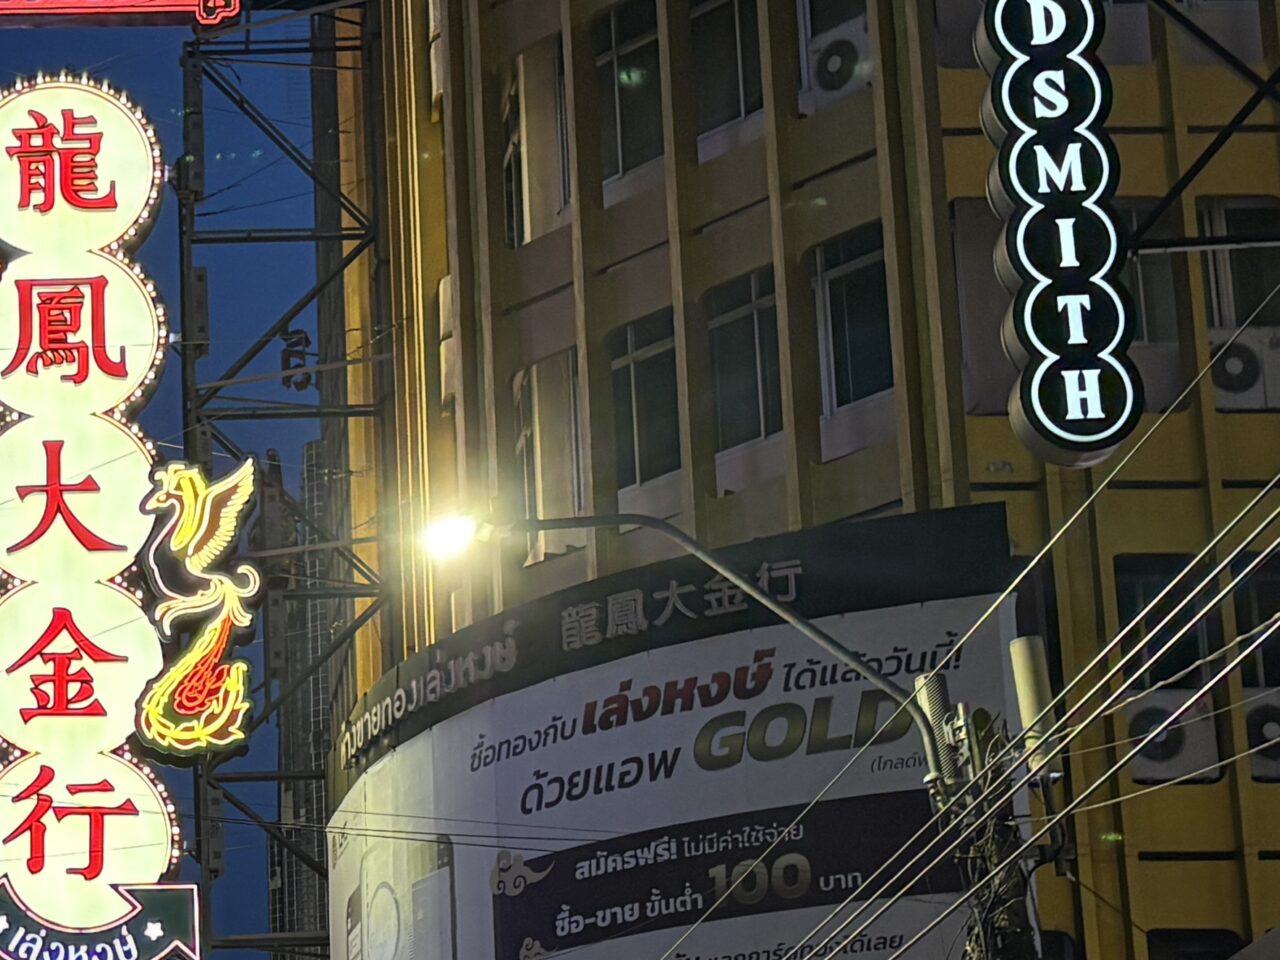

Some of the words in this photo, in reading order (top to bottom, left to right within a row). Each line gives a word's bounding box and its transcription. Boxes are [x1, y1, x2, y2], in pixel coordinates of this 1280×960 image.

[0, 109, 139, 880] 龍鳳大金行
[560, 559, 803, 652] 龍鳳大金行
[469, 713, 578, 773] ซื้อทองกับ
[580, 648, 779, 735] เล่งหงษ์
[520, 741, 682, 816] ด้วยแอพ
[554, 894, 640, 939] ซื้อ-ขาย
[707, 851, 813, 908] 100
[819, 869, 863, 893] บาท
[575, 837, 677, 881] สมัครฟรี!
